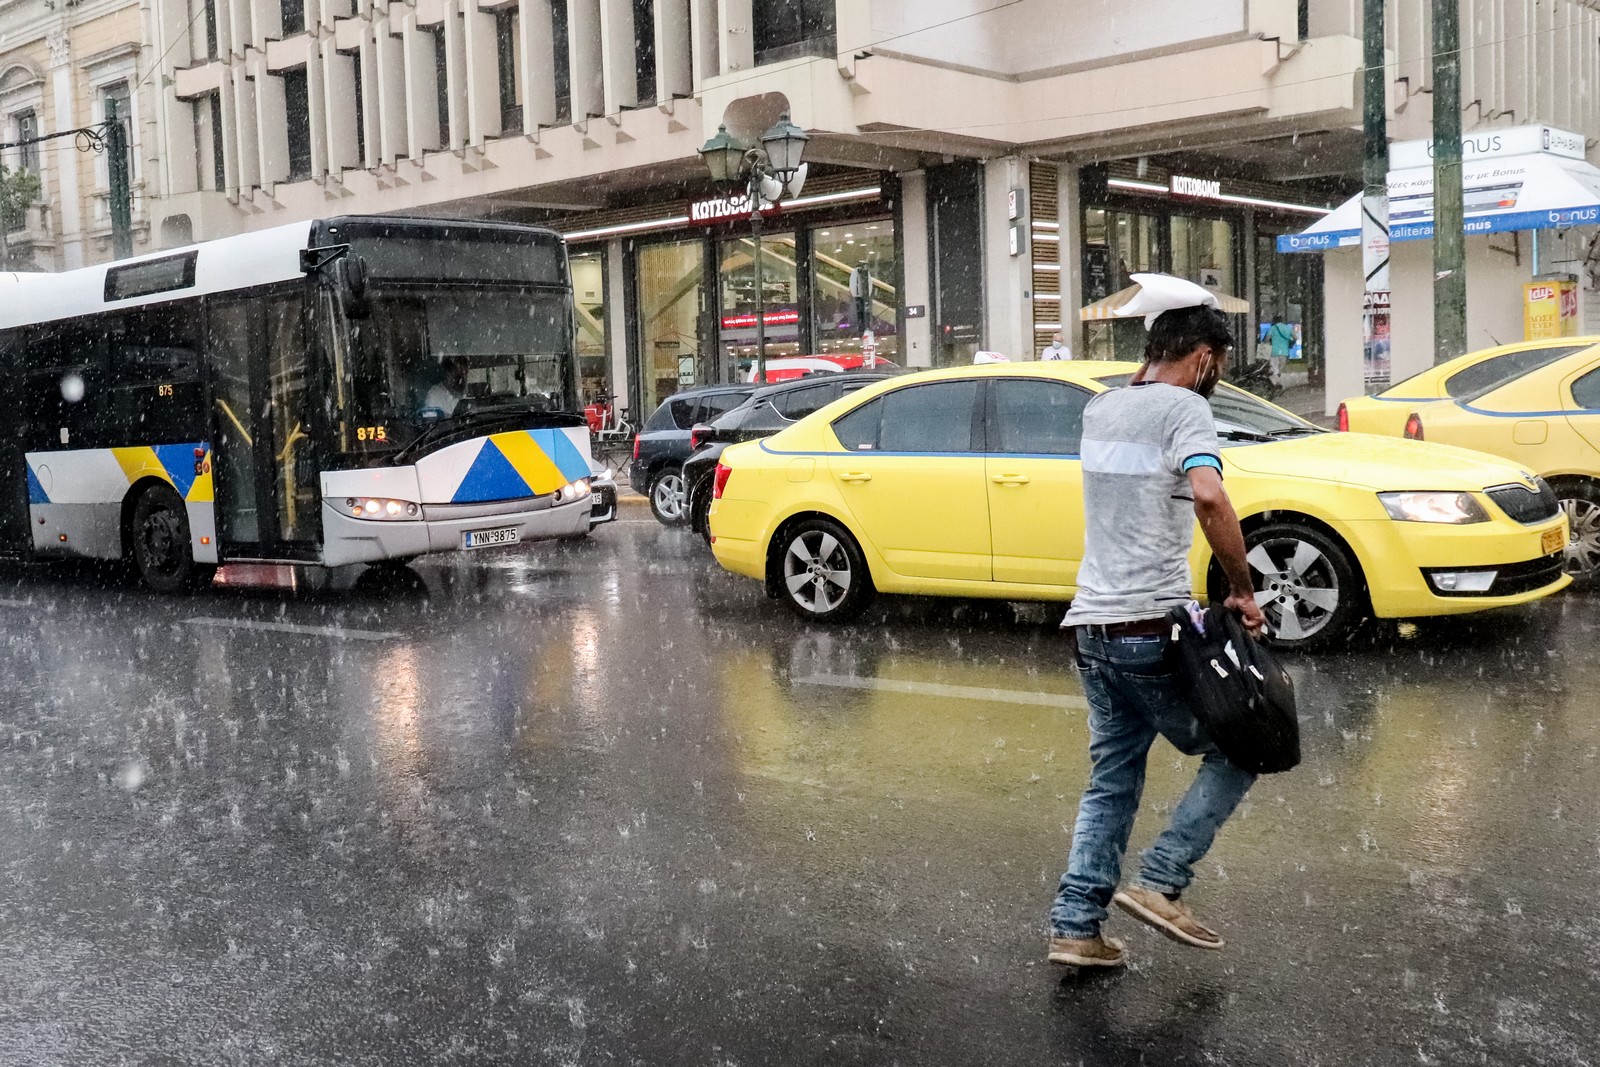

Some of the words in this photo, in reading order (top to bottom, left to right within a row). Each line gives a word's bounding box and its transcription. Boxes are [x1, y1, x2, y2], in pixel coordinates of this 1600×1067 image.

[1173, 175, 1220, 199] ΚΩΤΣΟΒΟΛΟΣ
[1549, 209, 1597, 223] bonus
[1290, 235, 1330, 247] bonus
[909, 307, 917, 315] 34
[159, 385, 172, 396] 875
[357, 426, 386, 440] 875
[474, 529, 516, 544] YNN-9875
